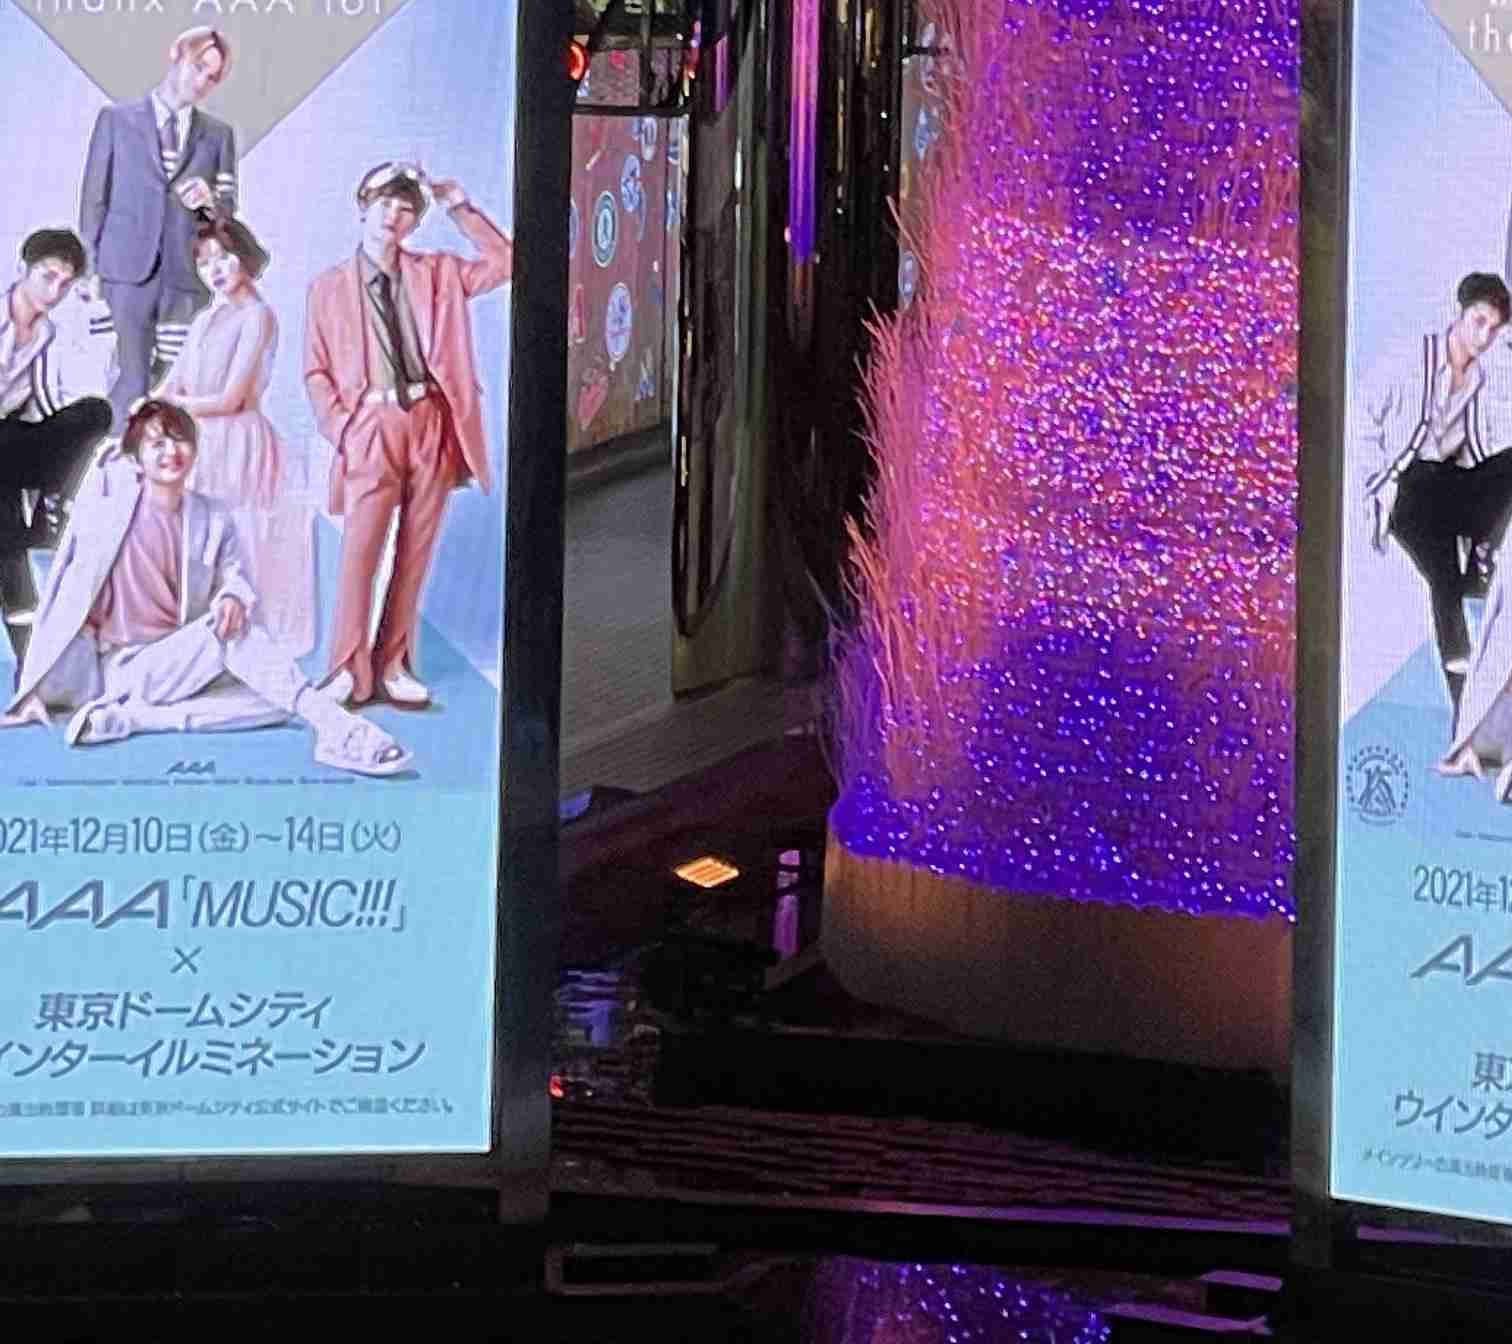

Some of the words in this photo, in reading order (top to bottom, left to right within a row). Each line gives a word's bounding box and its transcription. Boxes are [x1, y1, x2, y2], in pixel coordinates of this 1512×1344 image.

[34, 990, 333, 1032] 東京ドームシティ
